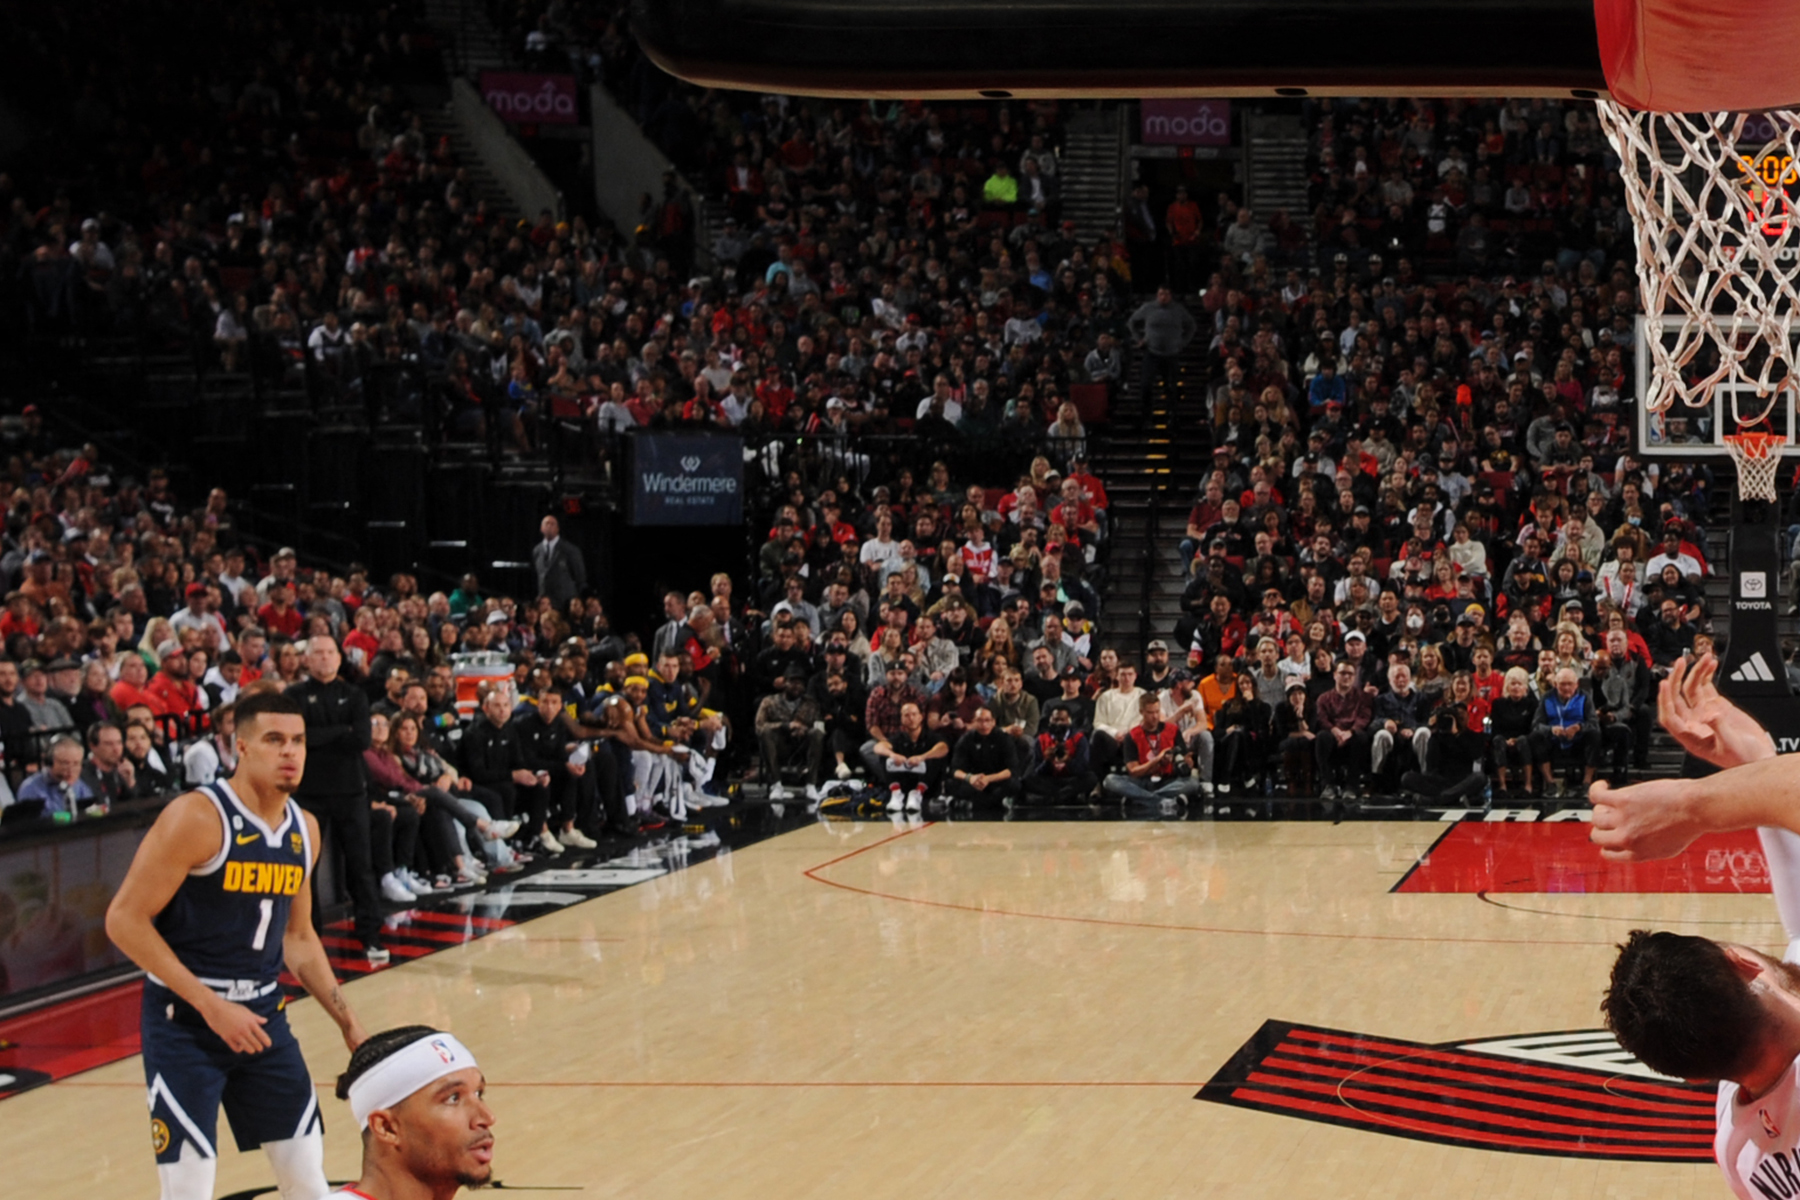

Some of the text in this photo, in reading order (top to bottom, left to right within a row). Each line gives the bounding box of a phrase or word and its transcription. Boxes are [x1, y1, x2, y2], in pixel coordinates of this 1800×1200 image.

[486, 81, 573, 114] moda
[1146, 105, 1227, 137] moda
[643, 473, 737, 493] Windermere
[1736, 602, 1771, 610] TOYOTA
[223, 861, 304, 896] DENVER
[252, 899, 273, 951] 1
